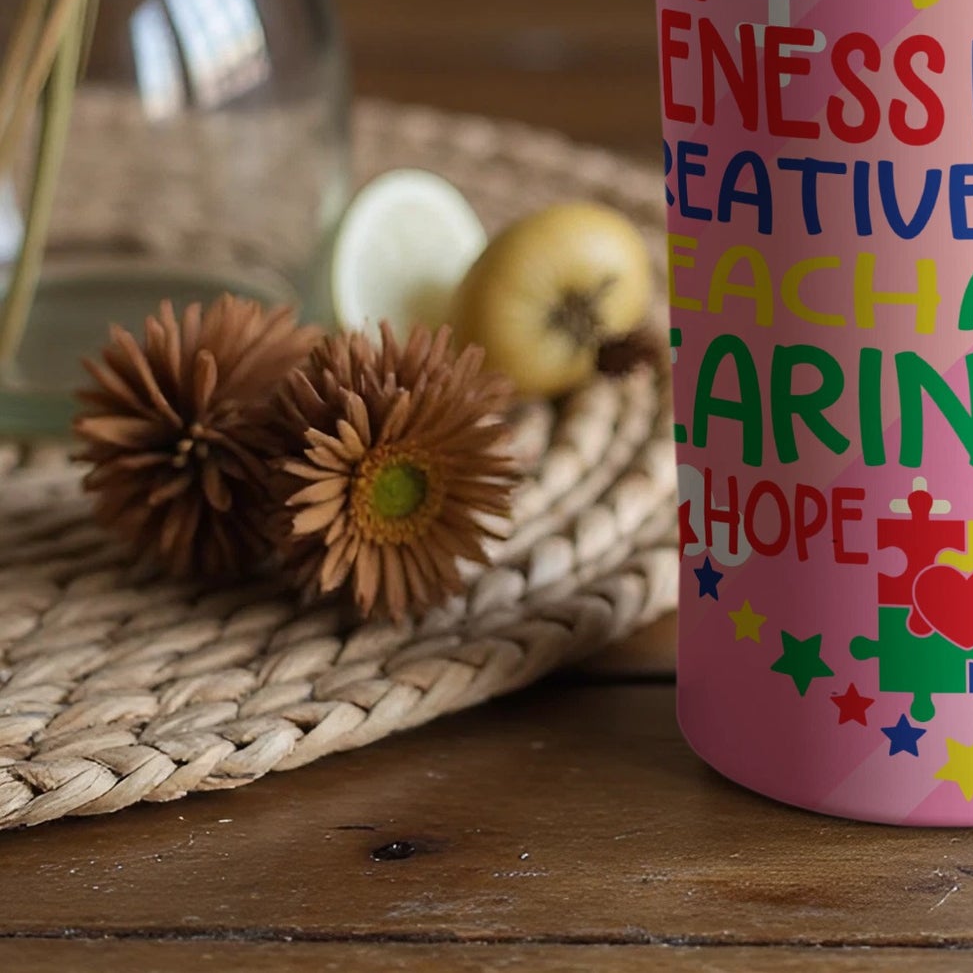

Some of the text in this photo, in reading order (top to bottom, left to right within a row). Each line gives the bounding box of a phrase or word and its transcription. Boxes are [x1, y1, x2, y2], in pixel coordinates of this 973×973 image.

[662, 9, 945, 146] ENESS
[667, 233, 941, 335] EACH
[704, 467, 869, 564] HOPE
